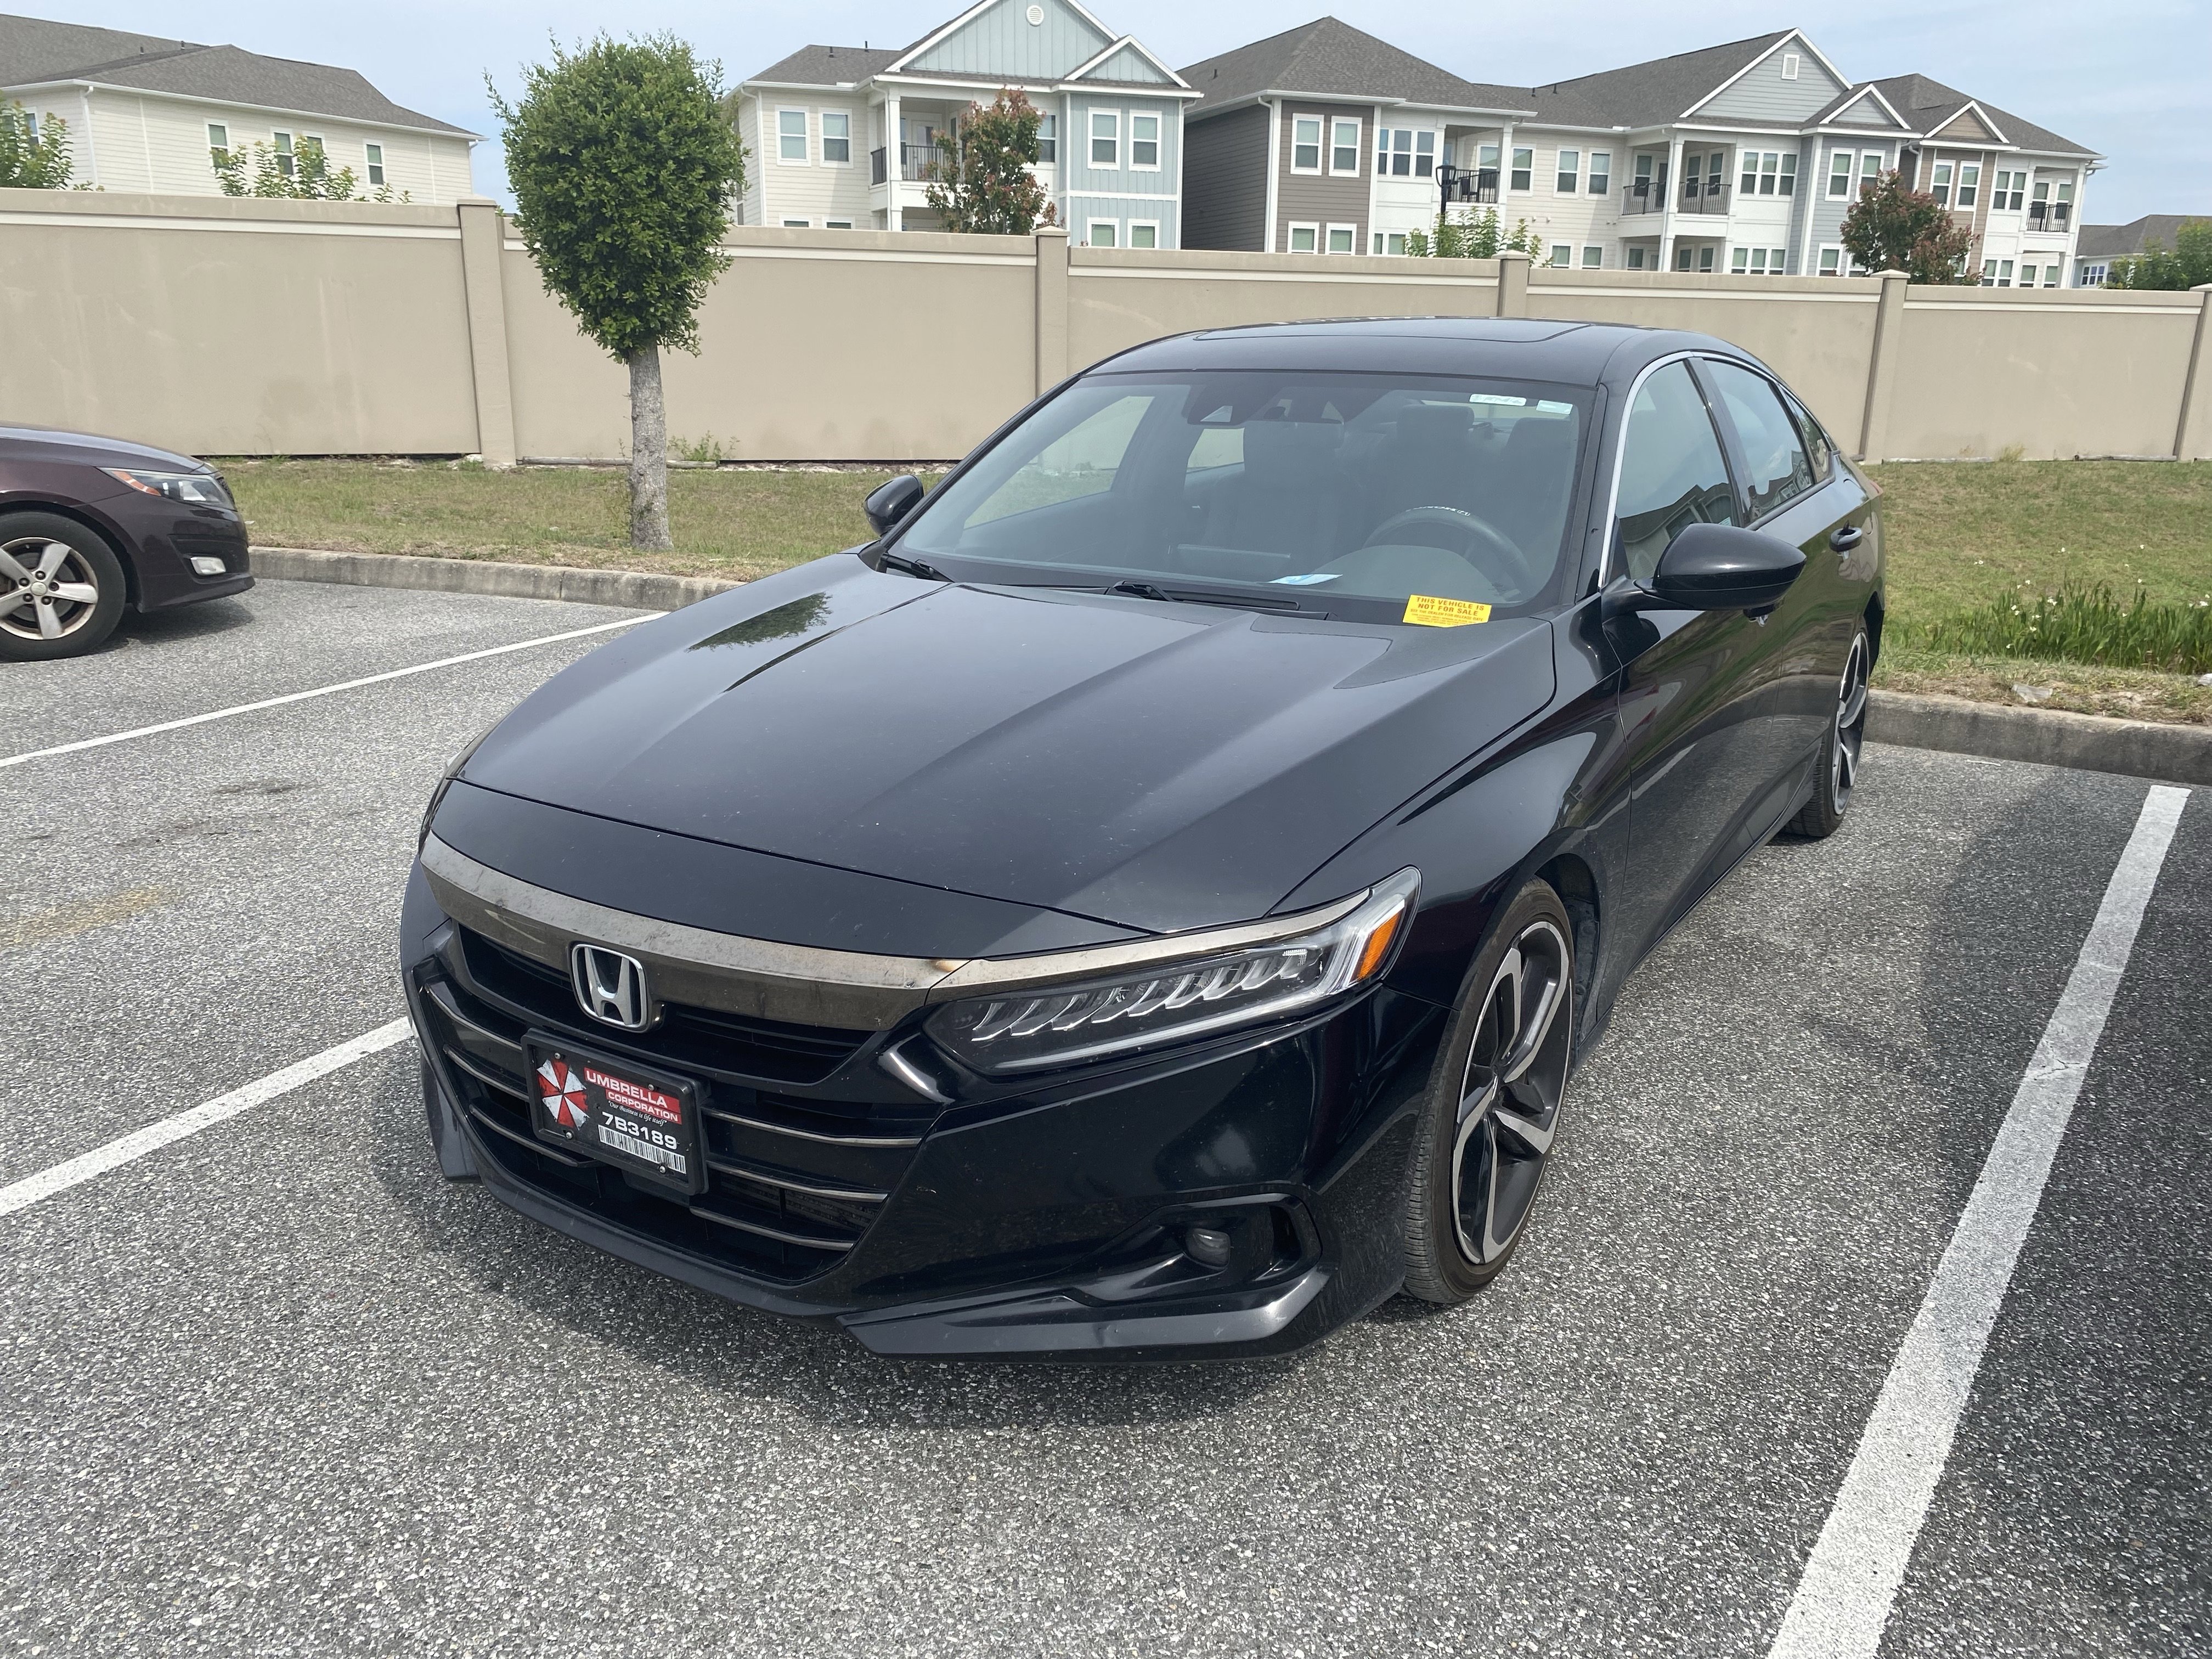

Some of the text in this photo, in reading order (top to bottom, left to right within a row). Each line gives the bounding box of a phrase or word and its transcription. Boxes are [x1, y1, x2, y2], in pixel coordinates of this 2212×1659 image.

[1438, 600, 1473, 609] VEHICLE
[585, 1070, 668, 1108] UMBRELLA
[608, 1092, 679, 1122] CORPORATION
[602, 1111, 677, 1150] 7B3189
